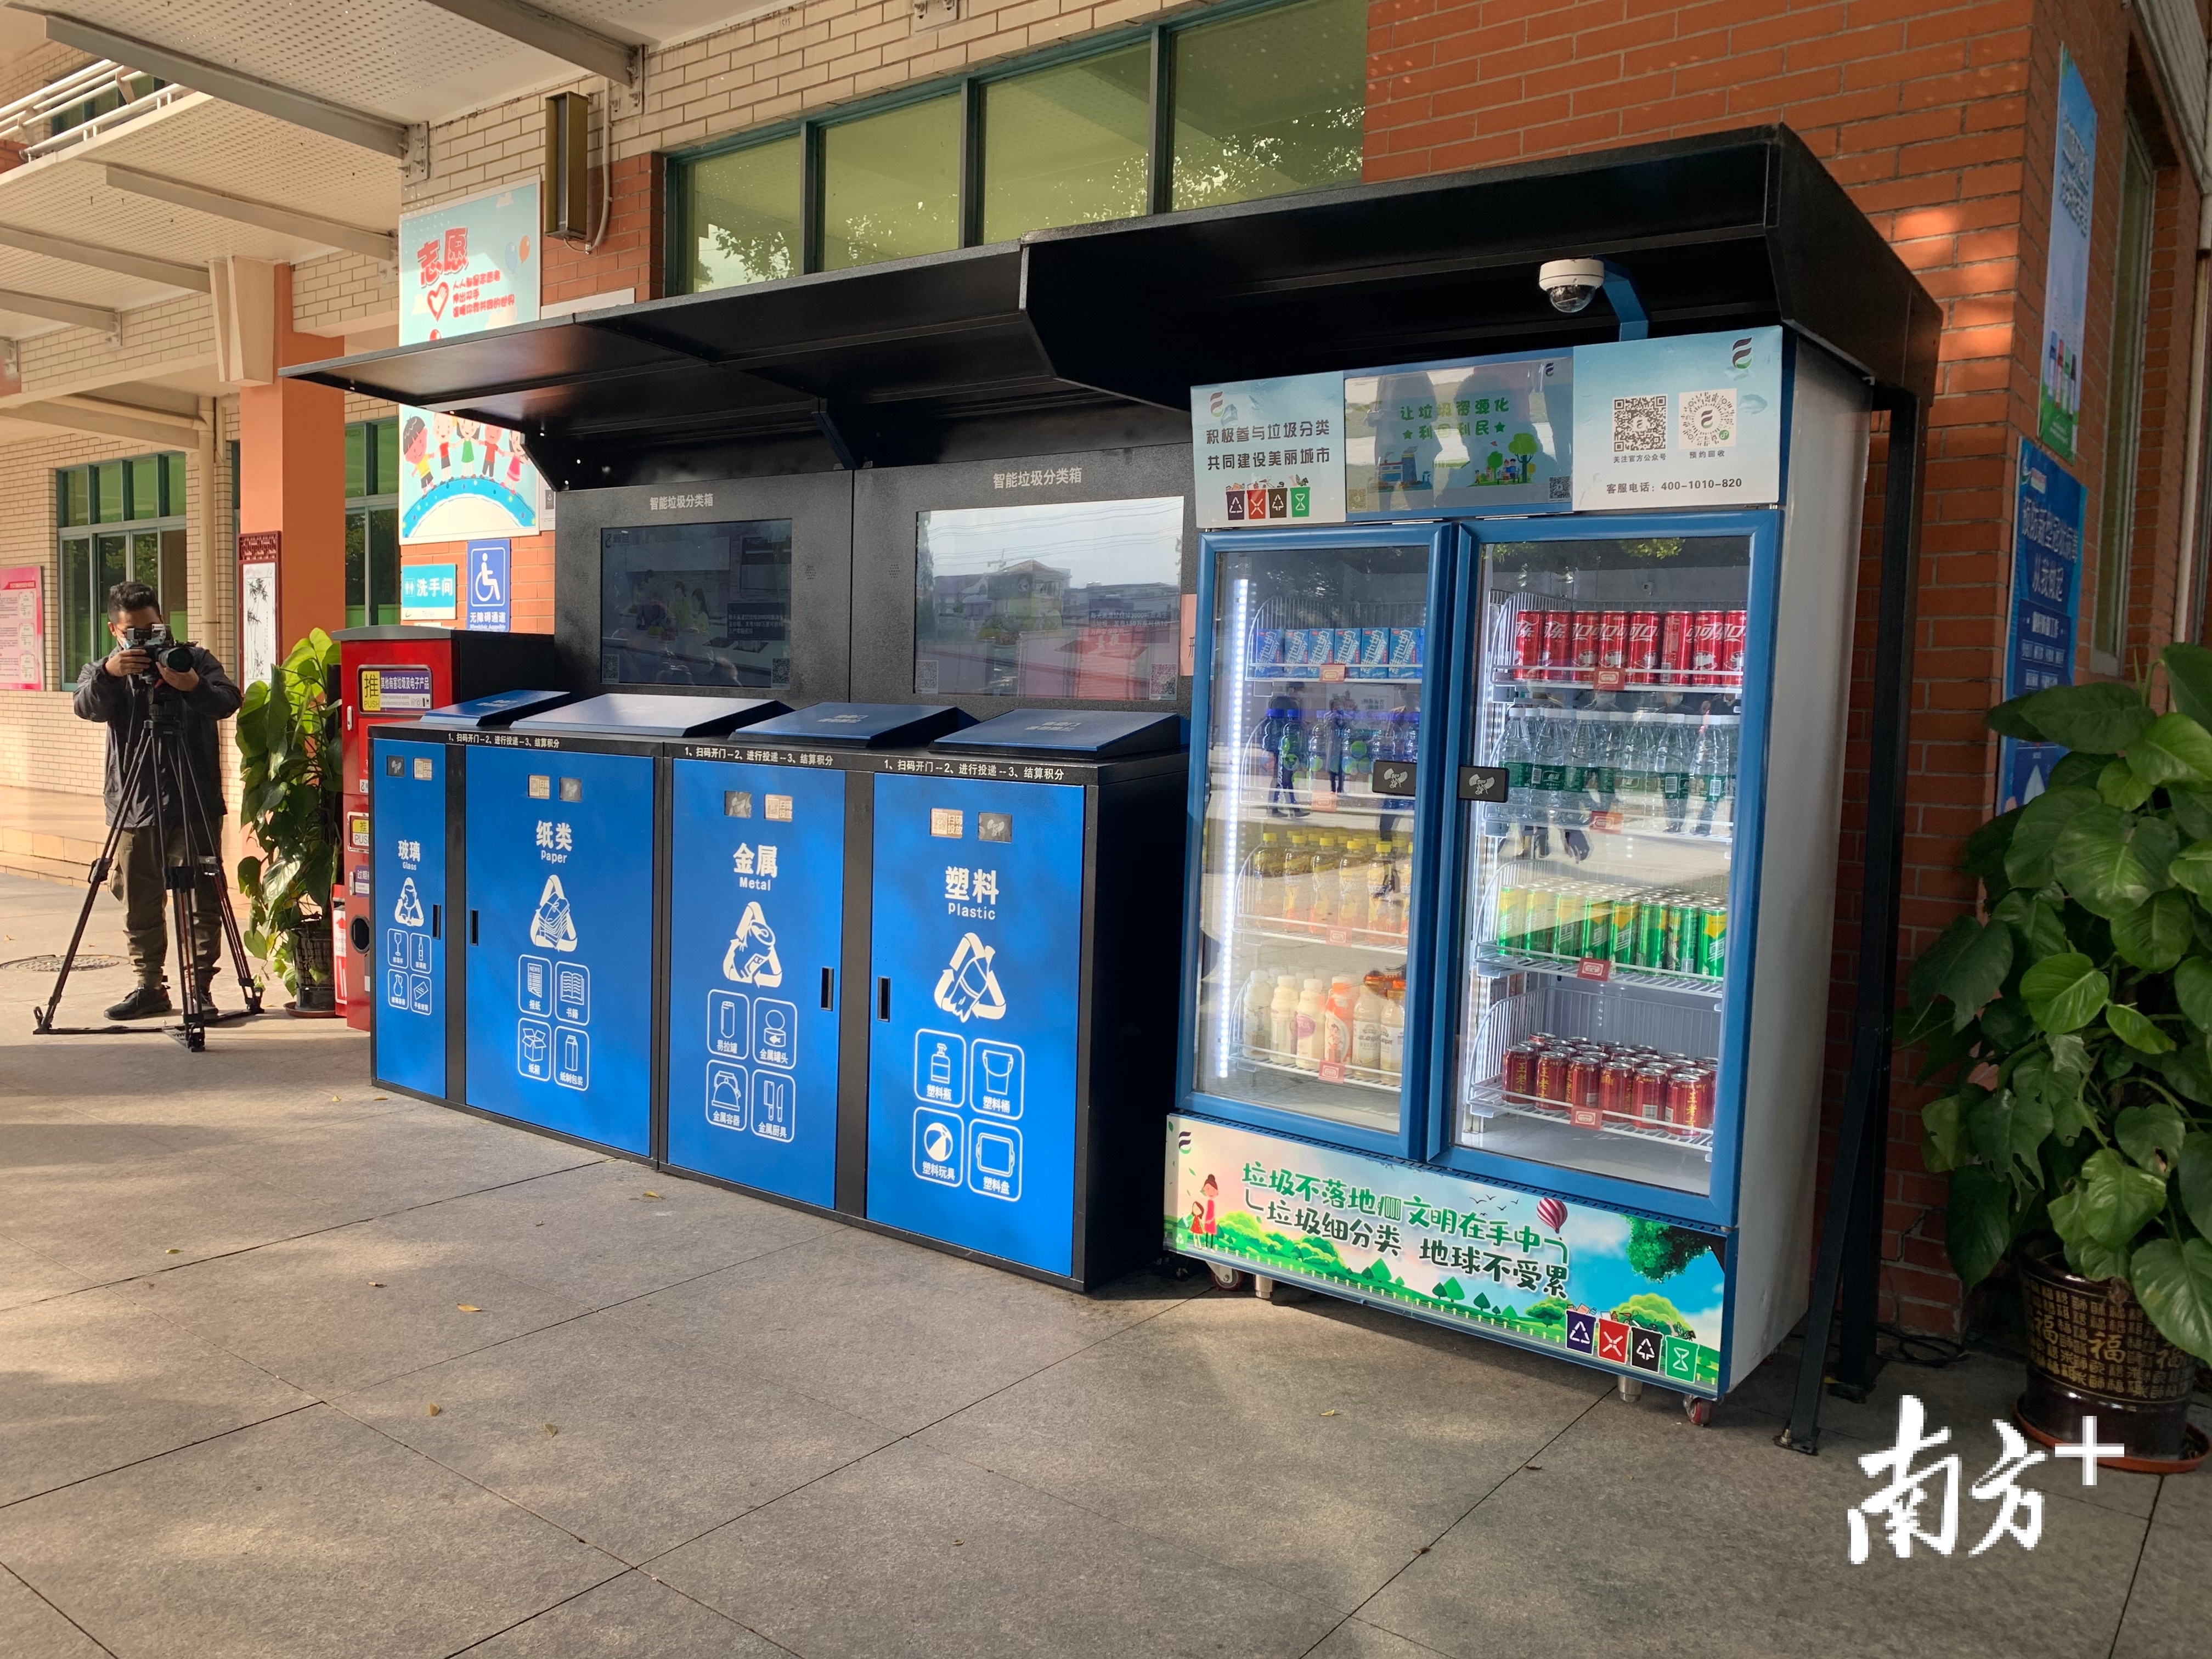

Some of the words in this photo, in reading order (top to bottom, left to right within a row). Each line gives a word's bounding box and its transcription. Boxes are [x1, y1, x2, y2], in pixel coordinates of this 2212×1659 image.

[417, 227, 469, 288] 志愿
[1206, 420, 1330, 444] 积极参与垃圾分类
[1207, 447, 1330, 470] 共同建设美丽城市
[1613, 453, 1666, 464] 关注官方公众号
[1689, 450, 1725, 459] 预约回收
[993, 466, 1082, 489] 智能垃圾分类箱
[650, 493, 713, 510] 智能垃圾分类箱
[416, 577, 453, 597] 洗手间
[470, 612, 506, 623] 无障碍通道
[364, 674, 379, 698] 推
[381, 676, 430, 690] 其他有害垃圾及电子产品
[354, 834, 369, 844] PUS
[536, 820, 573, 851] 纸类
[398, 840, 420, 862] 玻璃
[541, 850, 568, 864] Paper
[403, 862, 417, 871] Glass
[733, 843, 778, 878] 金属
[740, 877, 771, 891] Metal
[945, 866, 999, 905] 塑料
[948, 902, 996, 921] Plastic
[414, 1001, 428, 1012] 平板玻璃
[529, 1000, 541, 1011] 报纸
[566, 1008, 578, 1019] 书籍
[716, 1040, 738, 1054] 易拉罐
[759, 1048, 788, 1064] 金属罐头
[528, 1063, 540, 1075] 纸箱
[560, 1071, 583, 1086] 纸制包装
[927, 1085, 952, 1102] 塑料瓶
[983, 1095, 1010, 1114] 塑料桶
[713, 1110, 740, 1126] 金属容器
[758, 1122, 787, 1138] 金属厨具
[922, 1161, 955, 1181] 塑料玩具
[983, 1176, 1009, 1195] 塑料盘
[1242, 1161, 1378, 1215] 垃圾不落地
[1403, 1194, 1541, 1252] 文明在手中
[1267, 1199, 1402, 1256] 垃圾细分类
[1419, 1237, 1568, 1300] 地球不受累
[2087, 1331, 2126, 1363] 福
